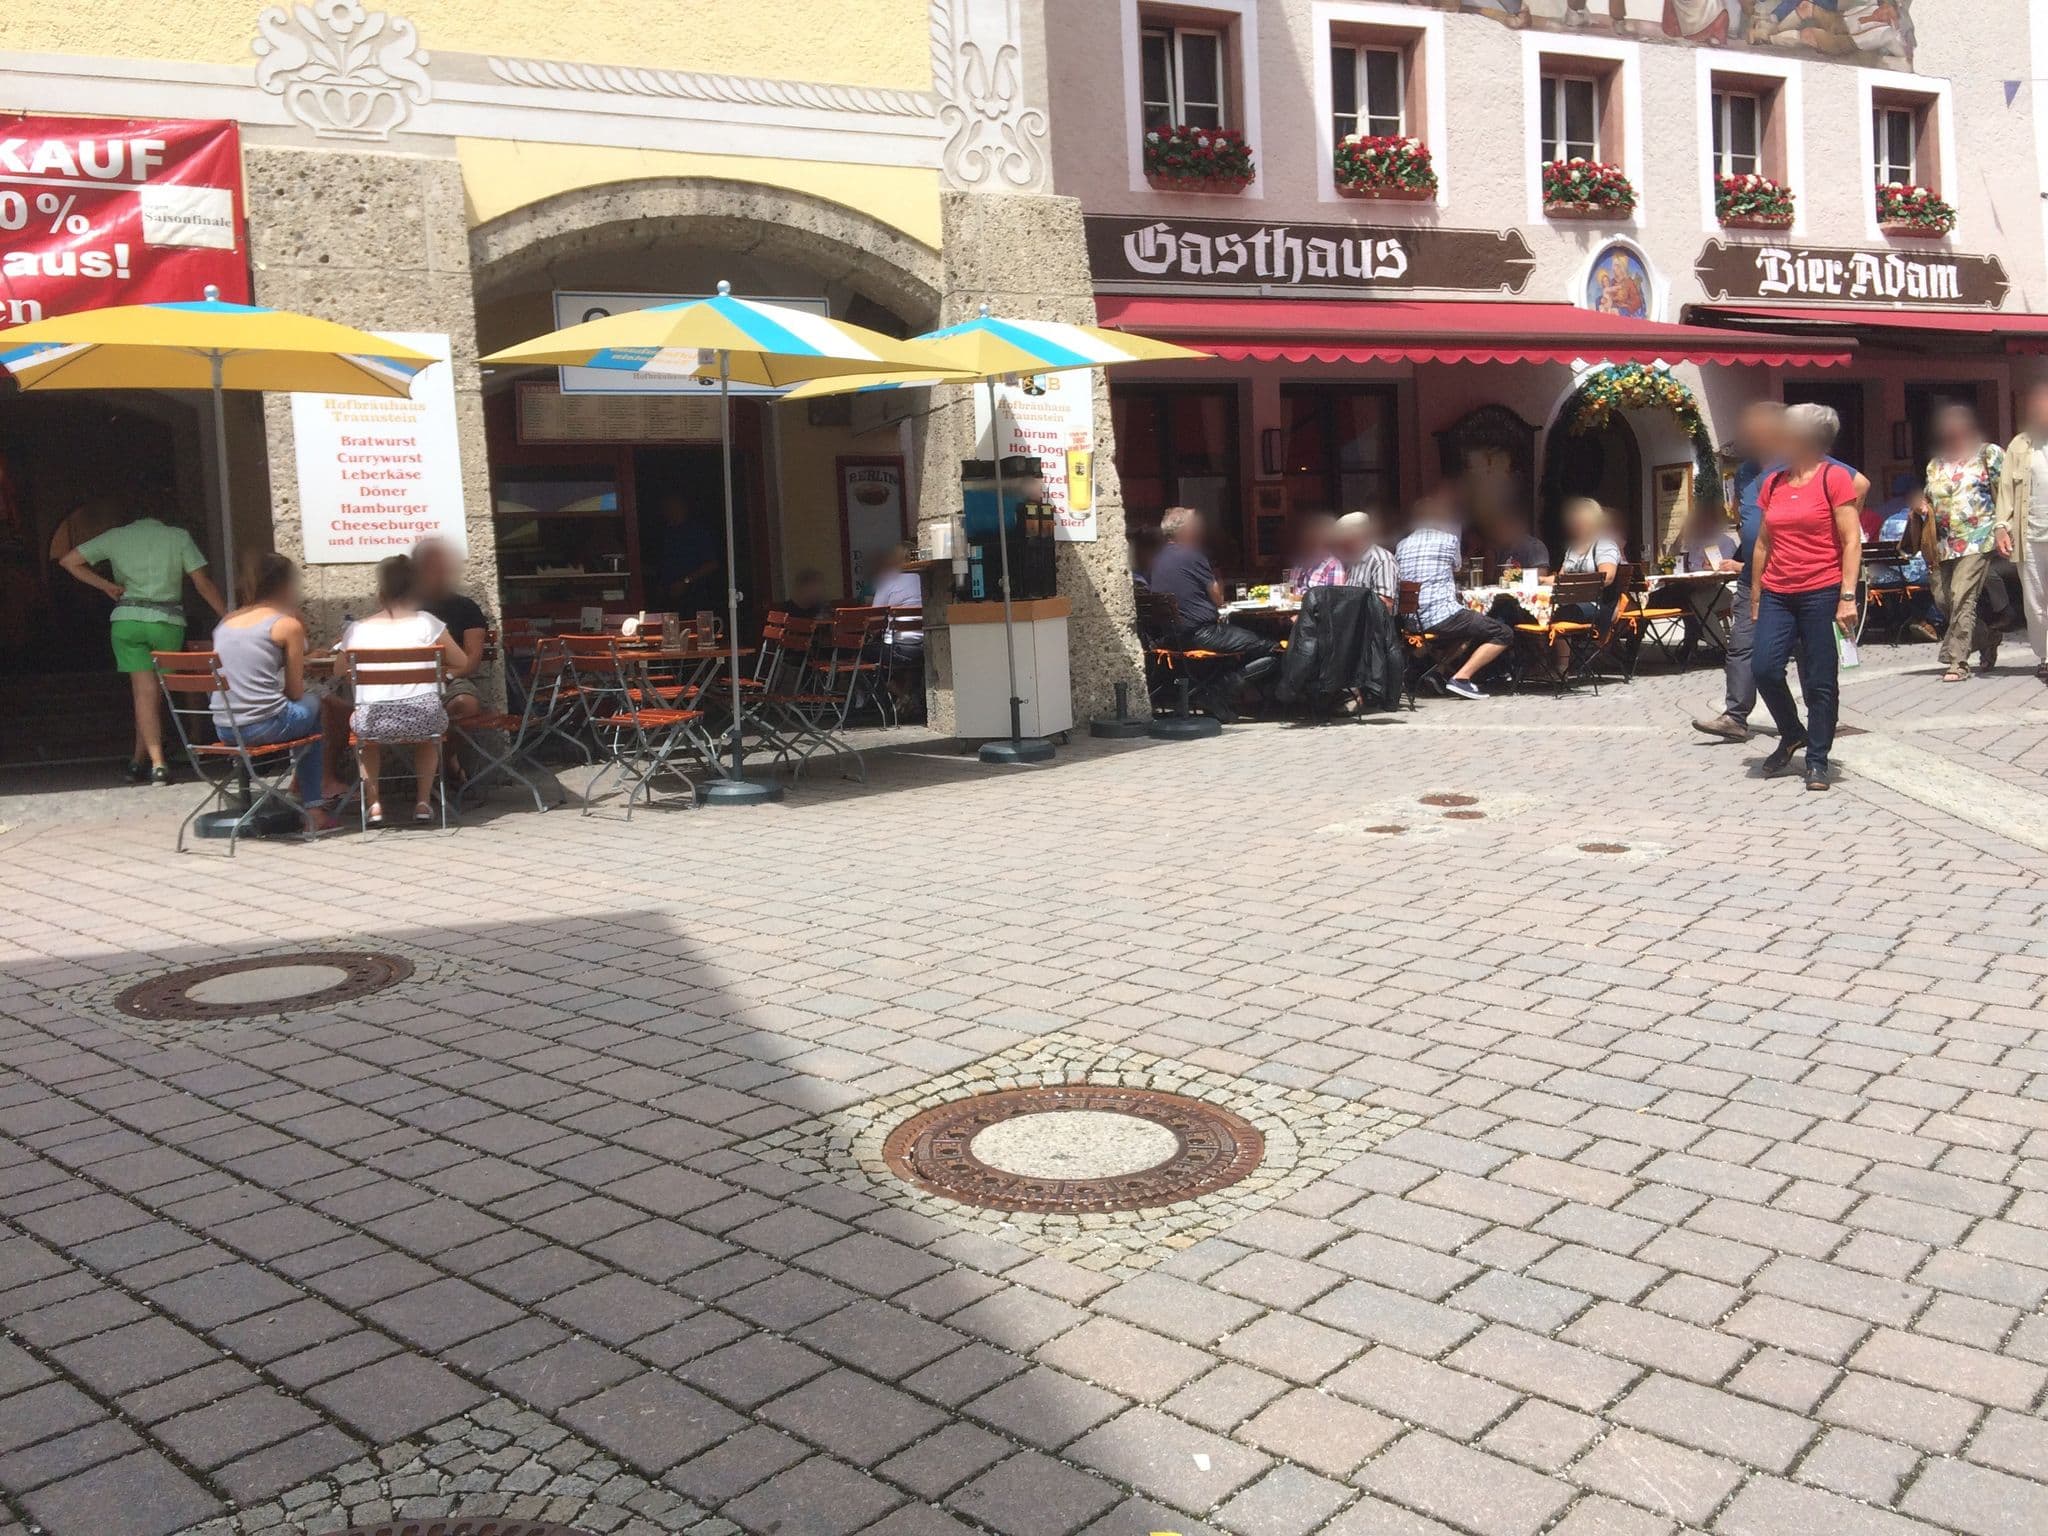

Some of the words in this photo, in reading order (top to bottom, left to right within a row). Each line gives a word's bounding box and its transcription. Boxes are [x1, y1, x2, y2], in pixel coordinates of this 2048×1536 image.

[1122, 222, 1409, 284] Gasthaus
[1013, 428, 1058, 439] Dürum
[341, 435, 417, 447] Bratwurst
[1008, 443, 1065, 458] Hot-Dog
[337, 452, 423, 466] Currywurst
[341, 469, 422, 480] Leberkäse
[359, 484, 407, 497] Döner
[340, 503, 428, 516] Hamburger
[331, 520, 441, 532] Cheeseburger
[1060, 518, 1086, 528] Bier!
[328, 536, 354, 546] und
[358, 536, 410, 546] frisches
